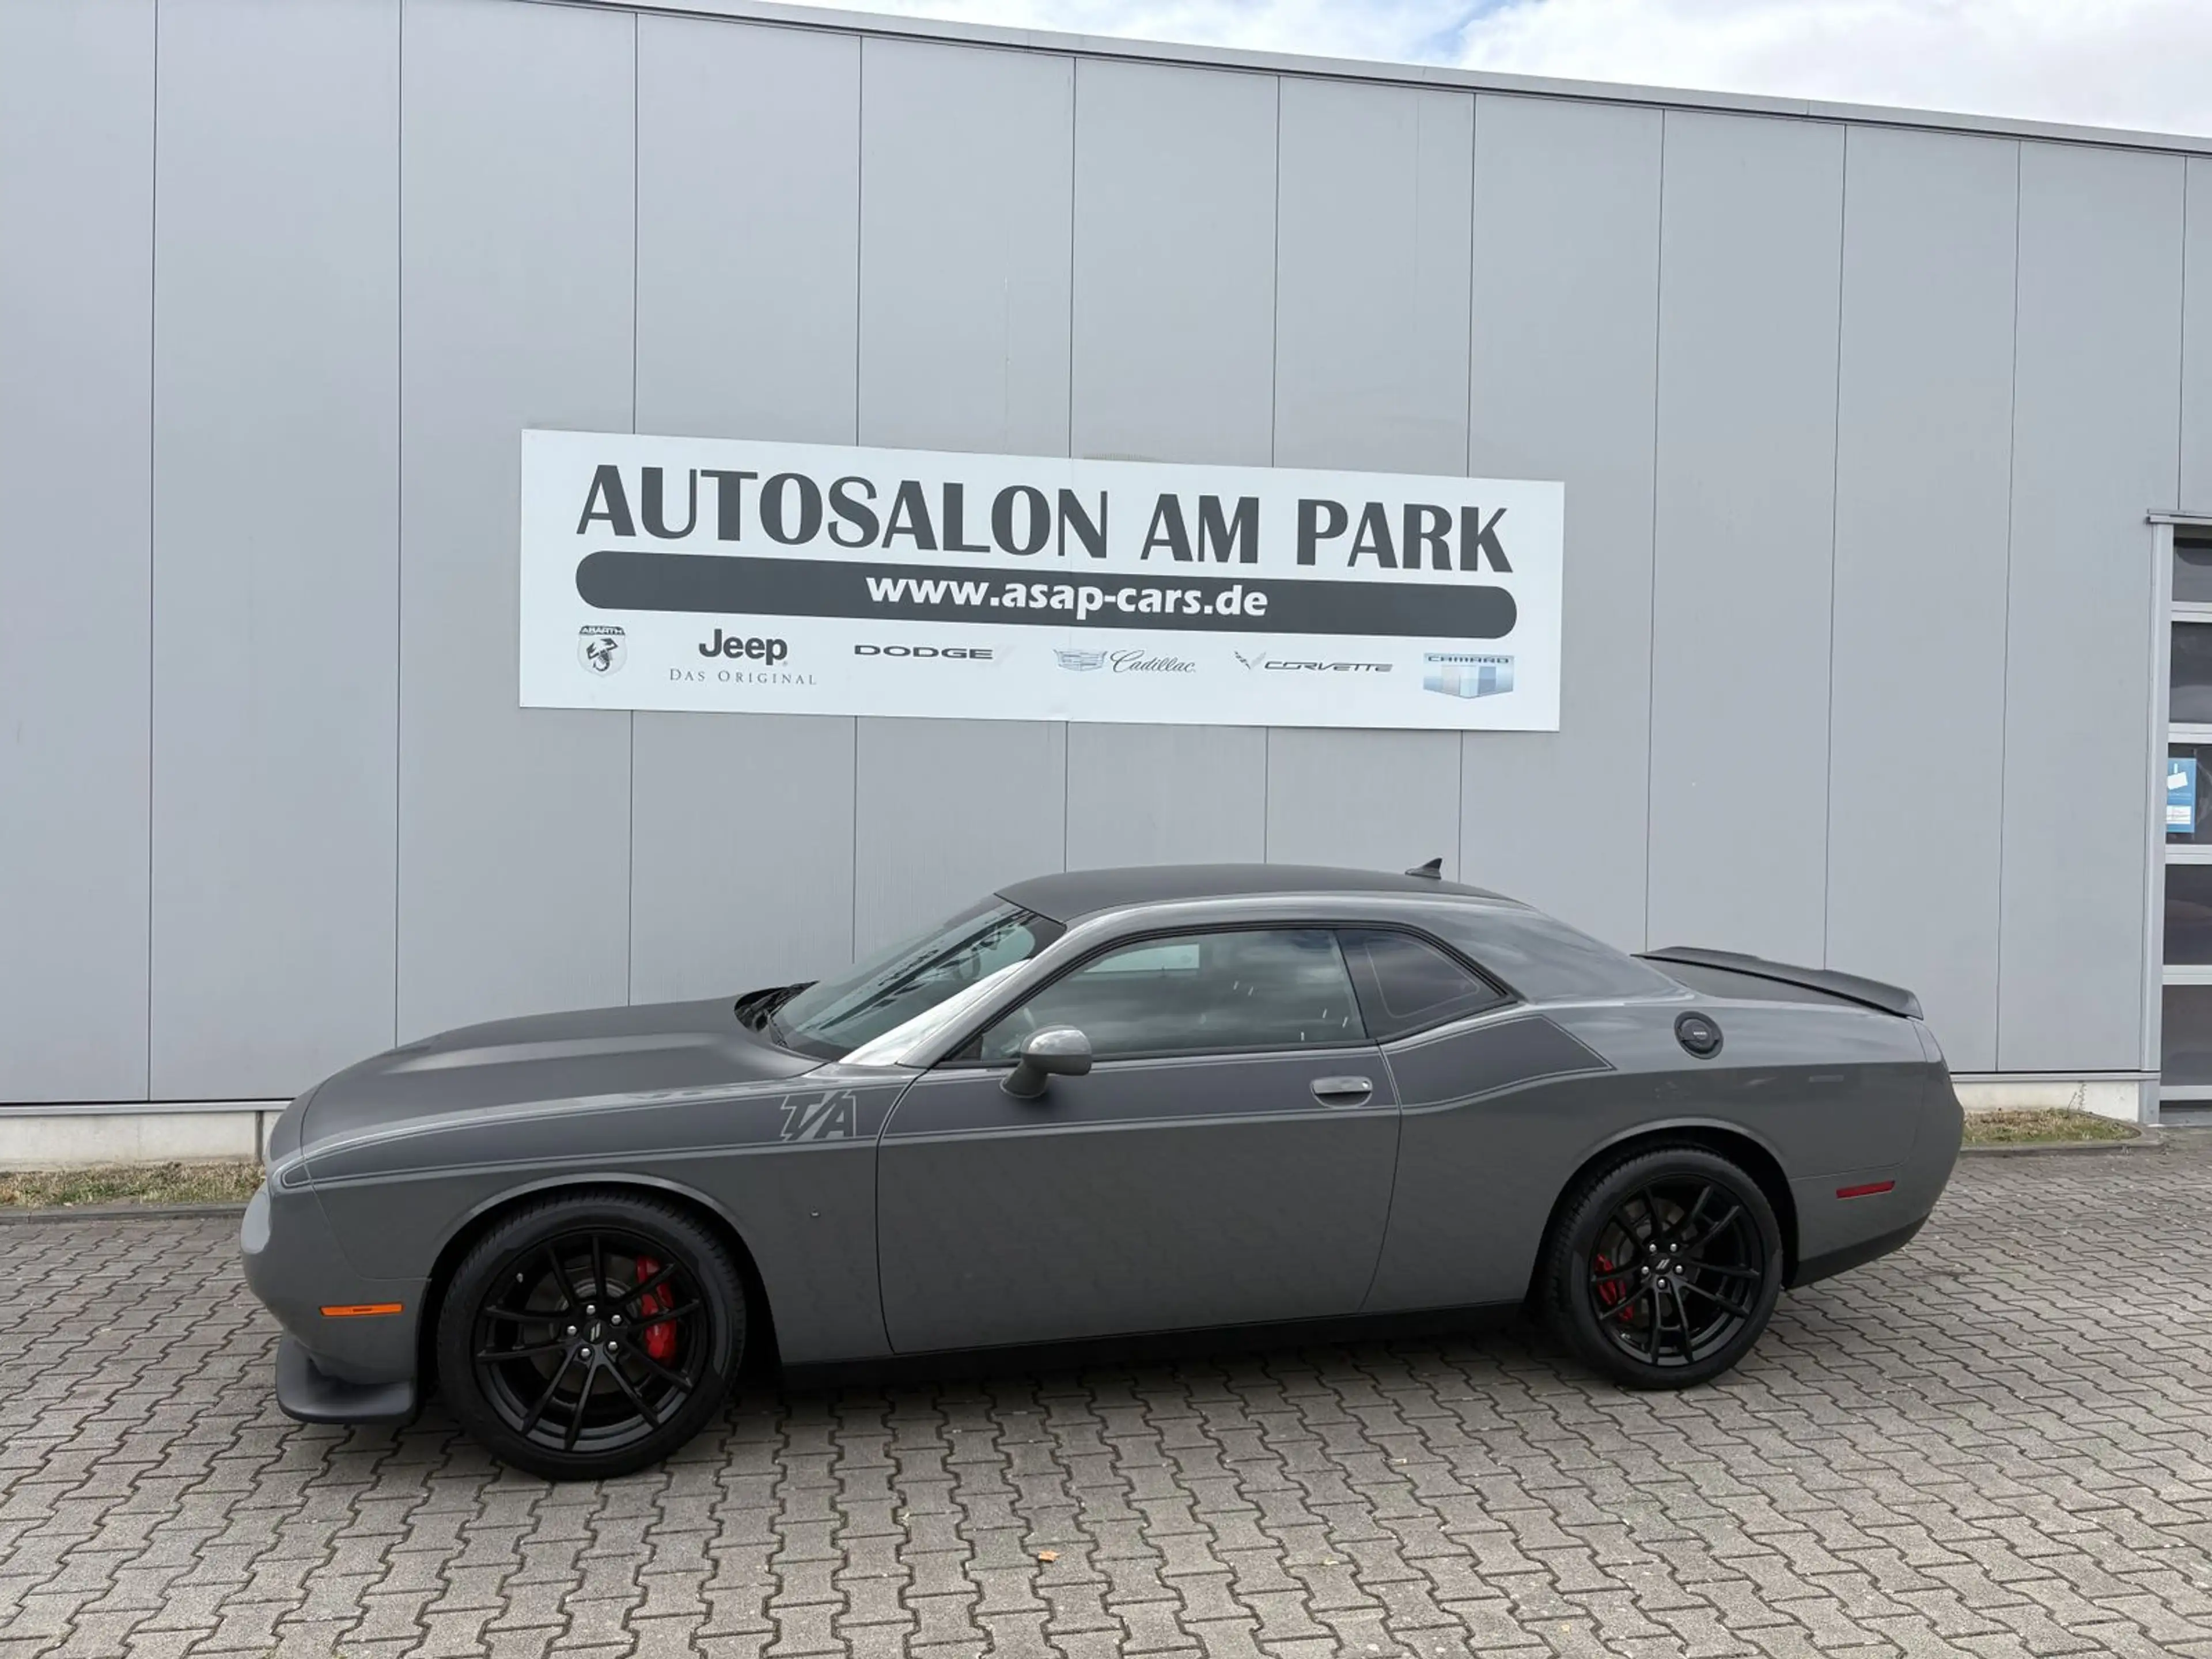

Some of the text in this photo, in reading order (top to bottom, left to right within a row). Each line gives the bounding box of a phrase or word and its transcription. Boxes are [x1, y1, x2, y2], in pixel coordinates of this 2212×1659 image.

[576, 464, 1514, 574] AUTOSALON AM PARK
[865, 576, 1268, 620] www.asap-cars.de
[581, 626, 623, 634] ABARTH
[698, 628, 788, 666] Jeep
[854, 644, 994, 660] DODGE
[1109, 650, 1195, 673] Cadillac
[1264, 661, 1393, 672] CORVETTE
[1427, 656, 1509, 664] CAMARO
